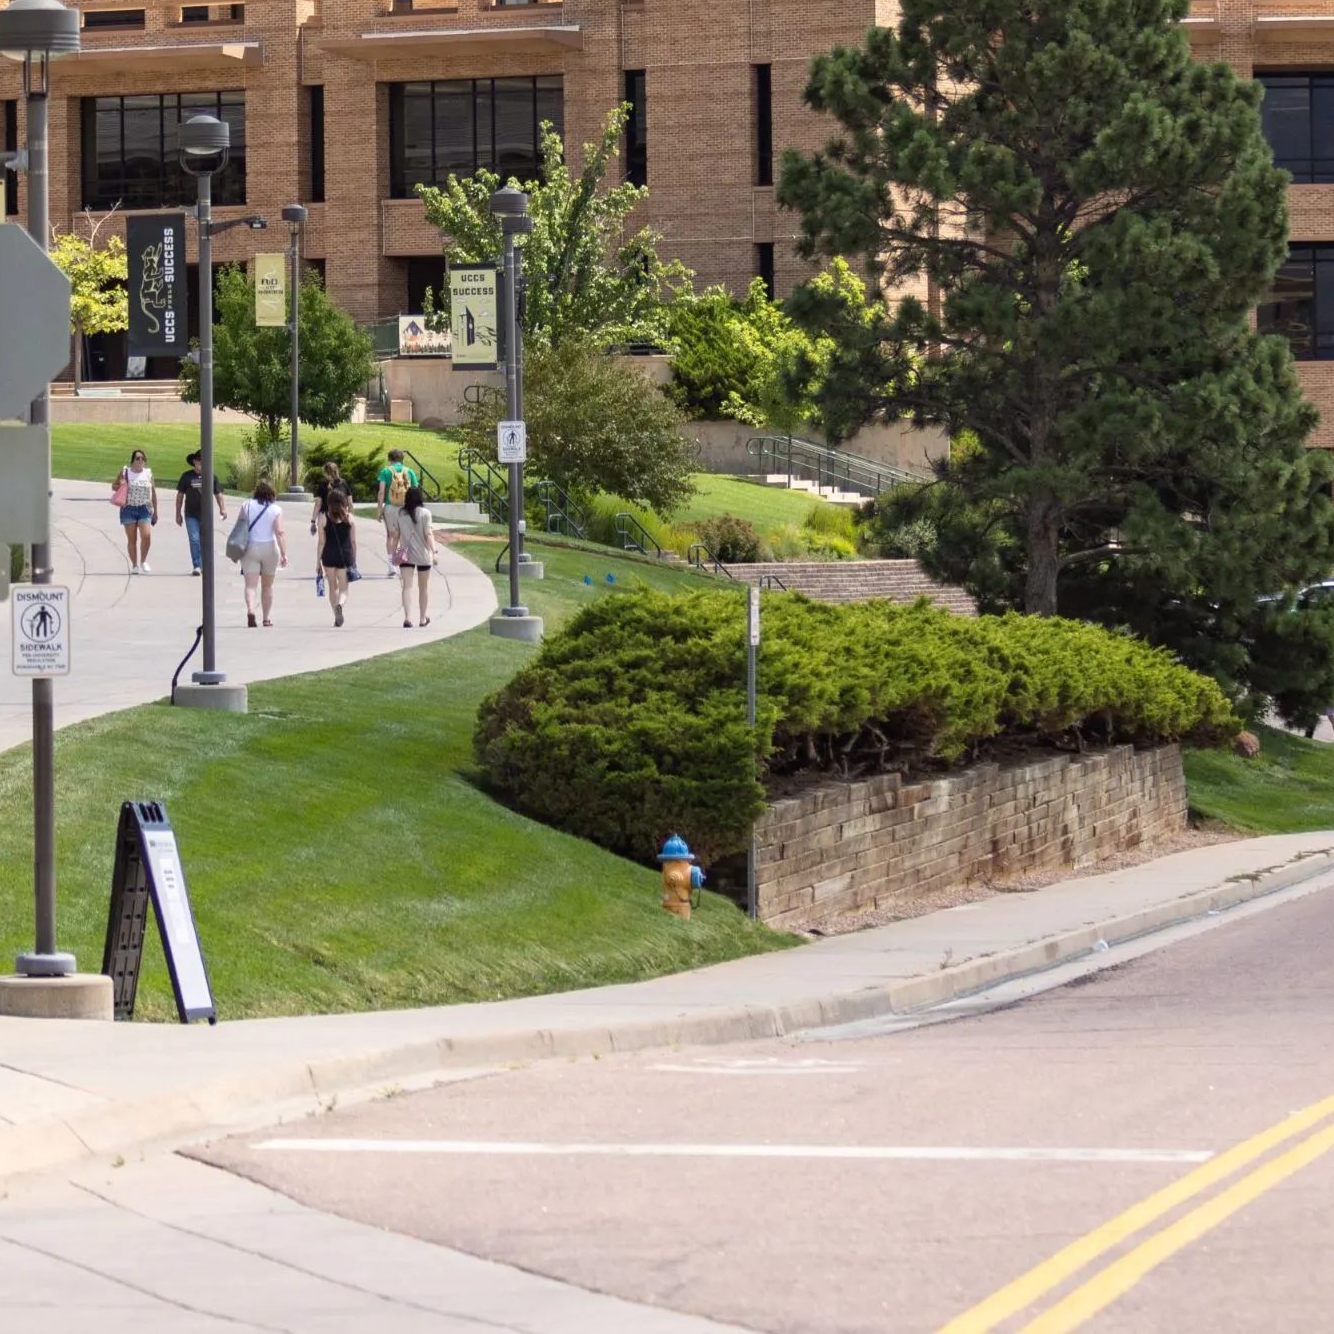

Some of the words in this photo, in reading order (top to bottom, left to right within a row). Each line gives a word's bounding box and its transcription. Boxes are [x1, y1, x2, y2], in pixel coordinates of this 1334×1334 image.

[164, 228, 175, 282] SUCCESS
[461, 274, 485, 282] UCCS
[452, 287, 494, 296] SUCCESS
[165, 311, 175, 343] UCCS
[17, 593, 63, 601] DISMOUNT
